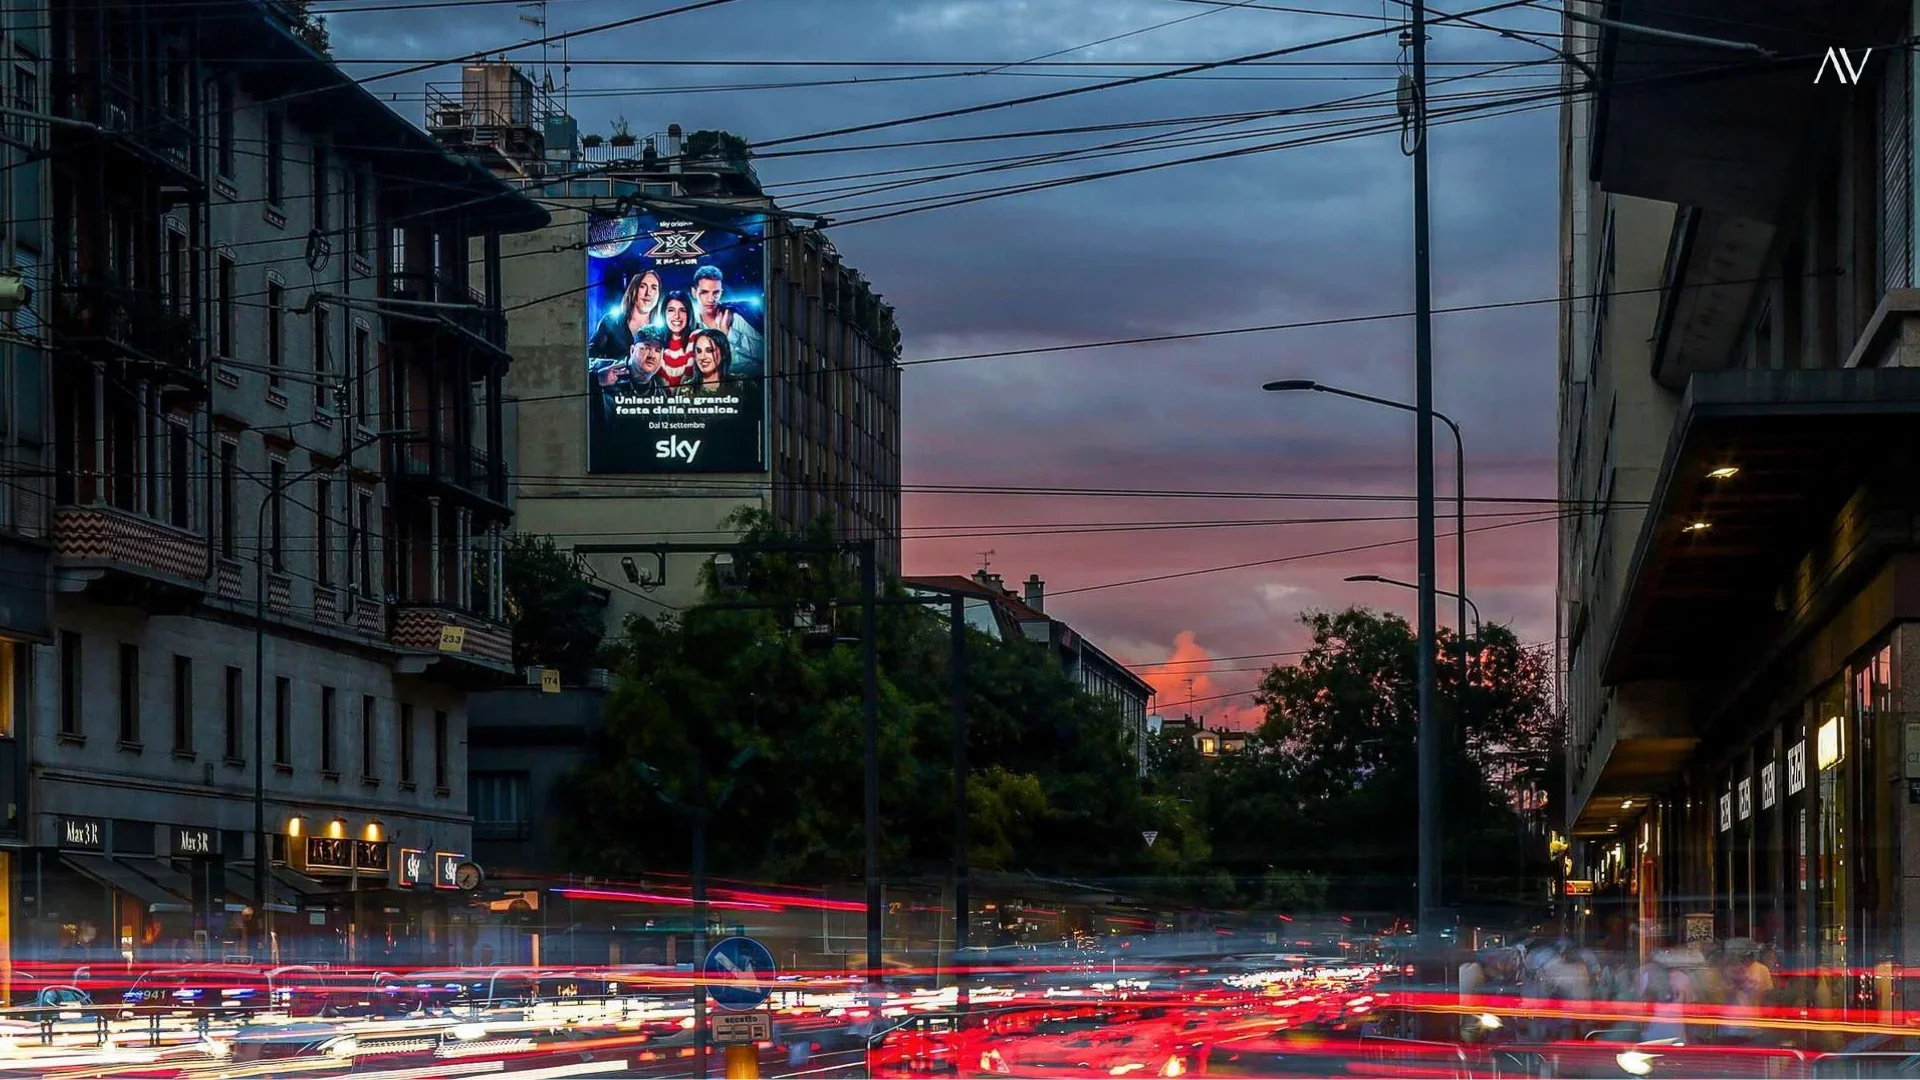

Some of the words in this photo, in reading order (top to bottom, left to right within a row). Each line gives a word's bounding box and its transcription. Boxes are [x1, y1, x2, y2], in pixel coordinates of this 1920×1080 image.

[614, 396, 664, 404] Unisciti
[667, 396, 691, 404] alla
[693, 395, 739, 405] grande
[616, 406, 650, 414] festa
[652, 406, 684, 414] della
[687, 406, 738, 414] musica.
[655, 434, 701, 463] sky
[443, 635, 461, 644] 233
[544, 676, 558, 685] 174
[66, 821, 83, 842] Max
[724, 1016, 758, 1024] eccetto
